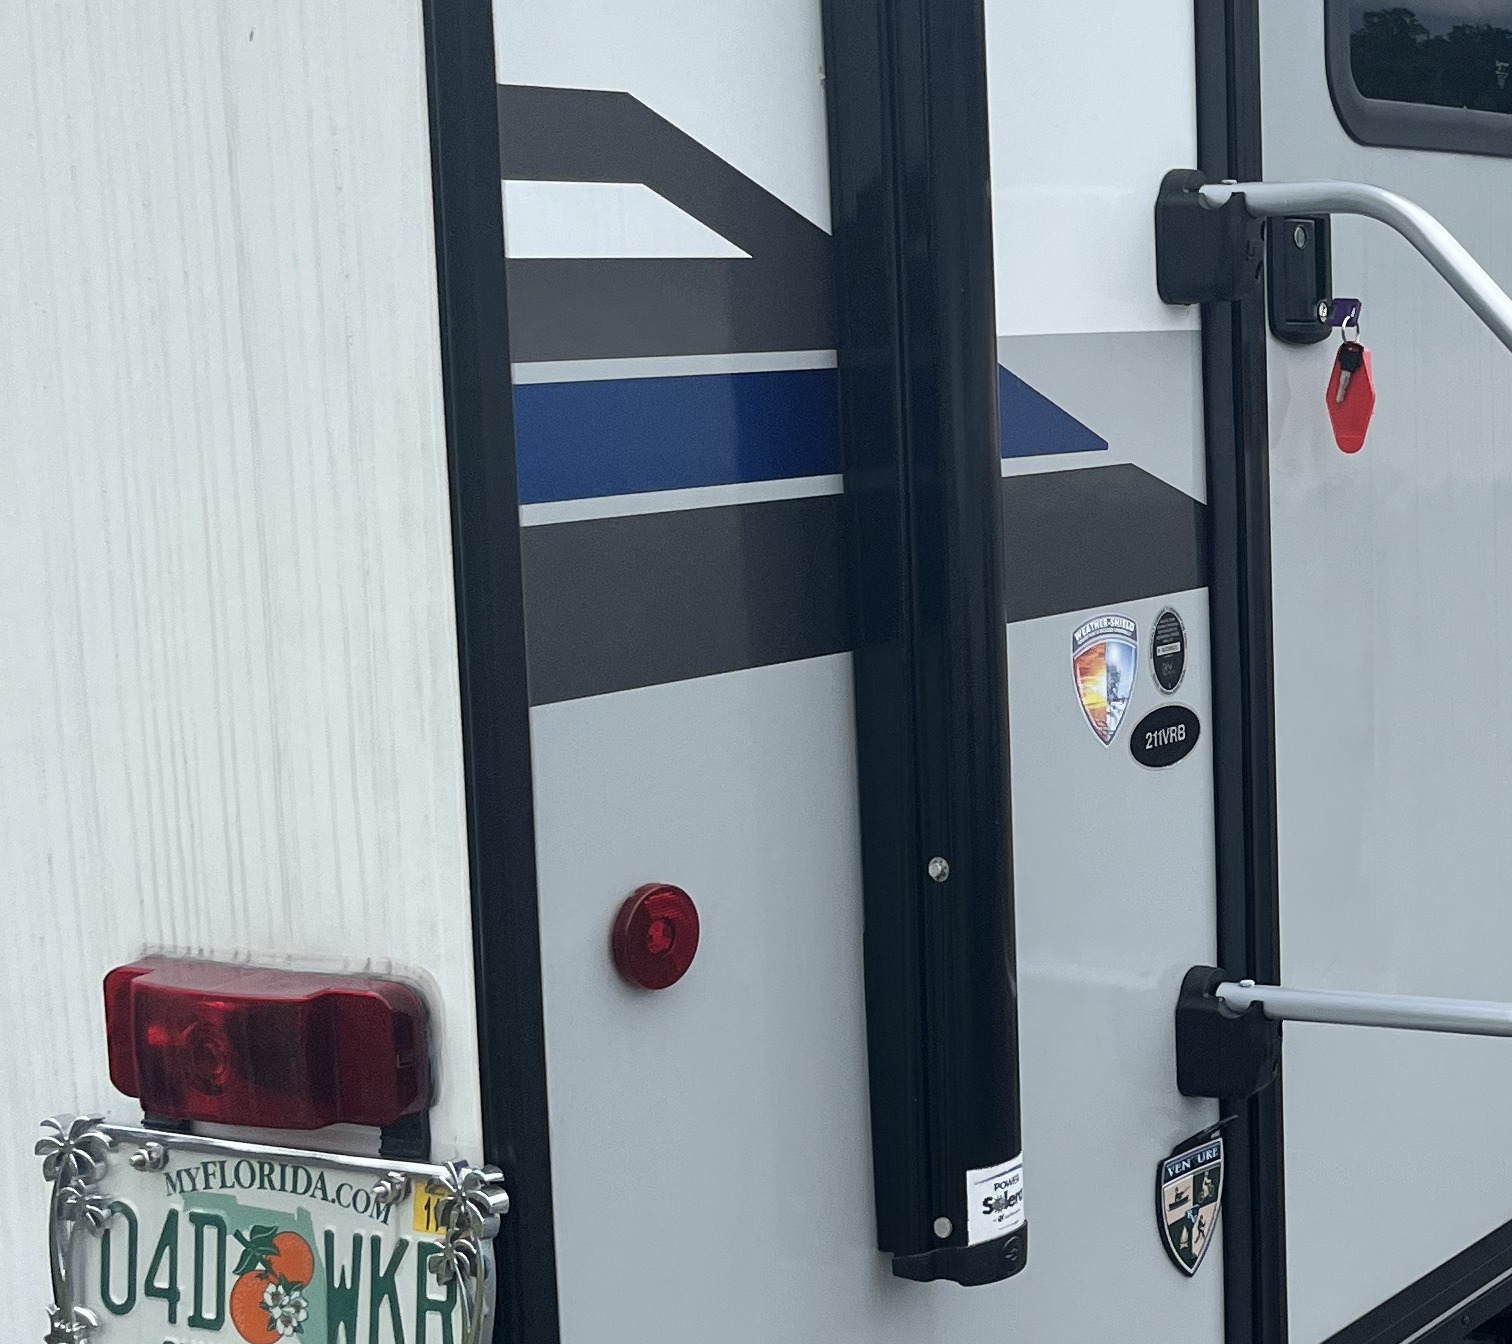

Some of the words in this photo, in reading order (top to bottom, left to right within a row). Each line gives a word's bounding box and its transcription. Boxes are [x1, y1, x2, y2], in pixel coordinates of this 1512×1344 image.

[1145, 723, 1186, 750] 211VRB
[163, 1158, 392, 1227] MYFLORIDA.COM
[100, 1199, 228, 1331] 04D
